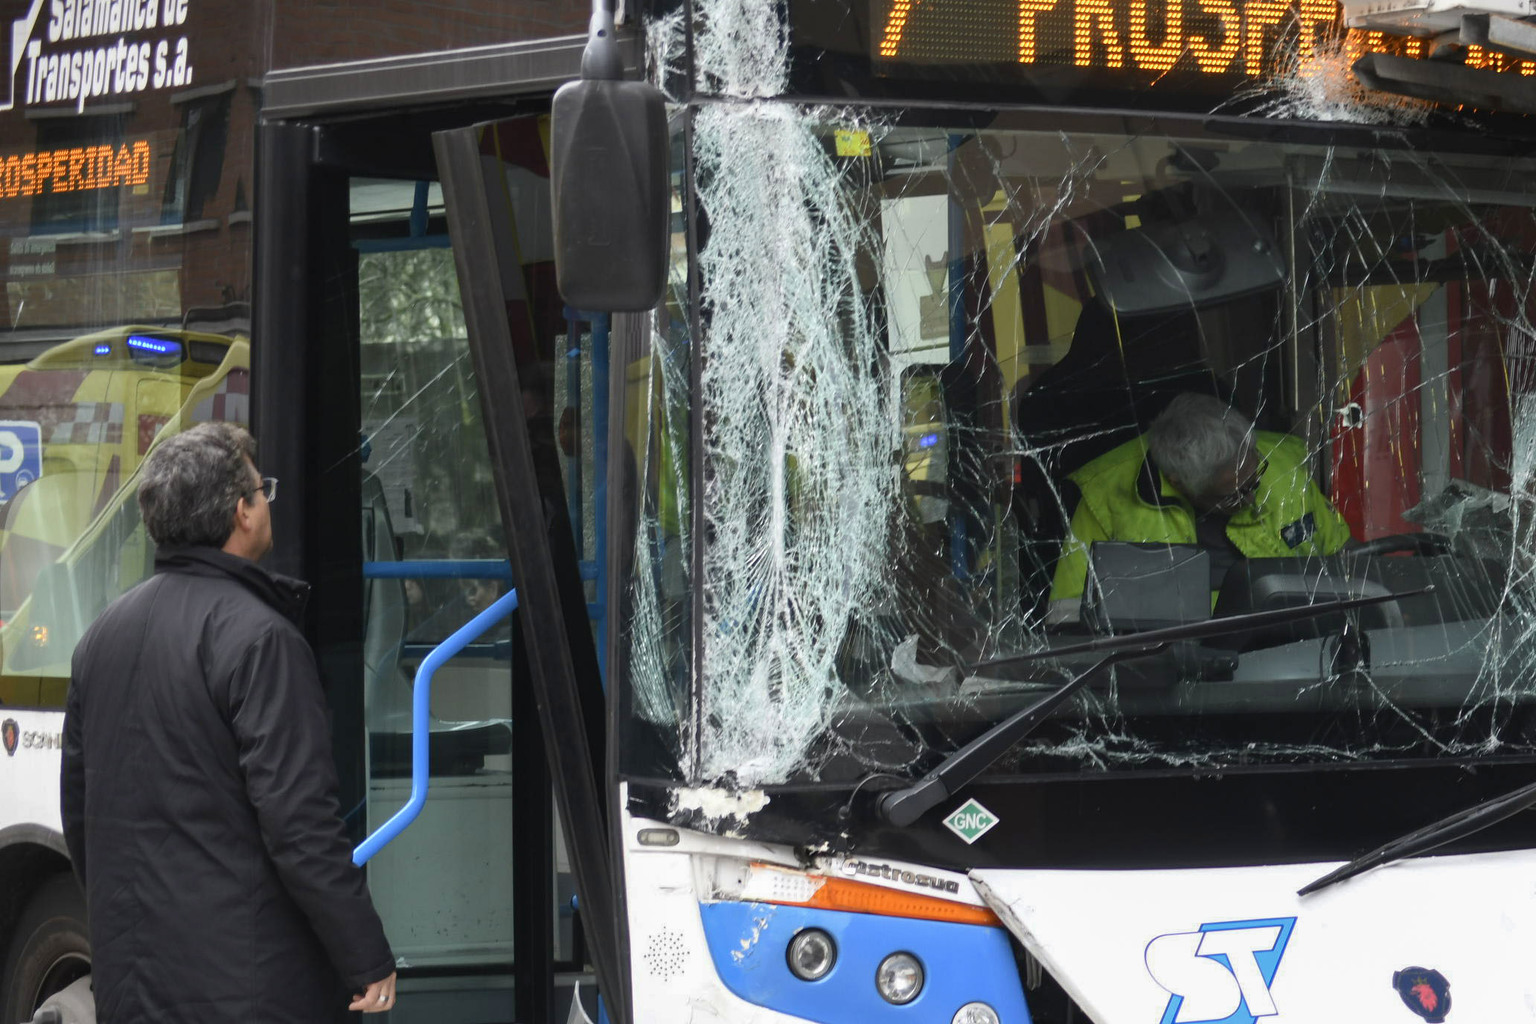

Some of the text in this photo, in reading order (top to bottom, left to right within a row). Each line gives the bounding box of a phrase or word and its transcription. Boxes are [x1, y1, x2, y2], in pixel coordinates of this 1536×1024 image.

[48, 0, 189, 43] Salamanca de
[26, 38, 151, 115] Transportes
[153, 37, 193, 89] s.a.
[0, 140, 150, 198] OSPERIDAD
[953, 812, 987, 830] GNC
